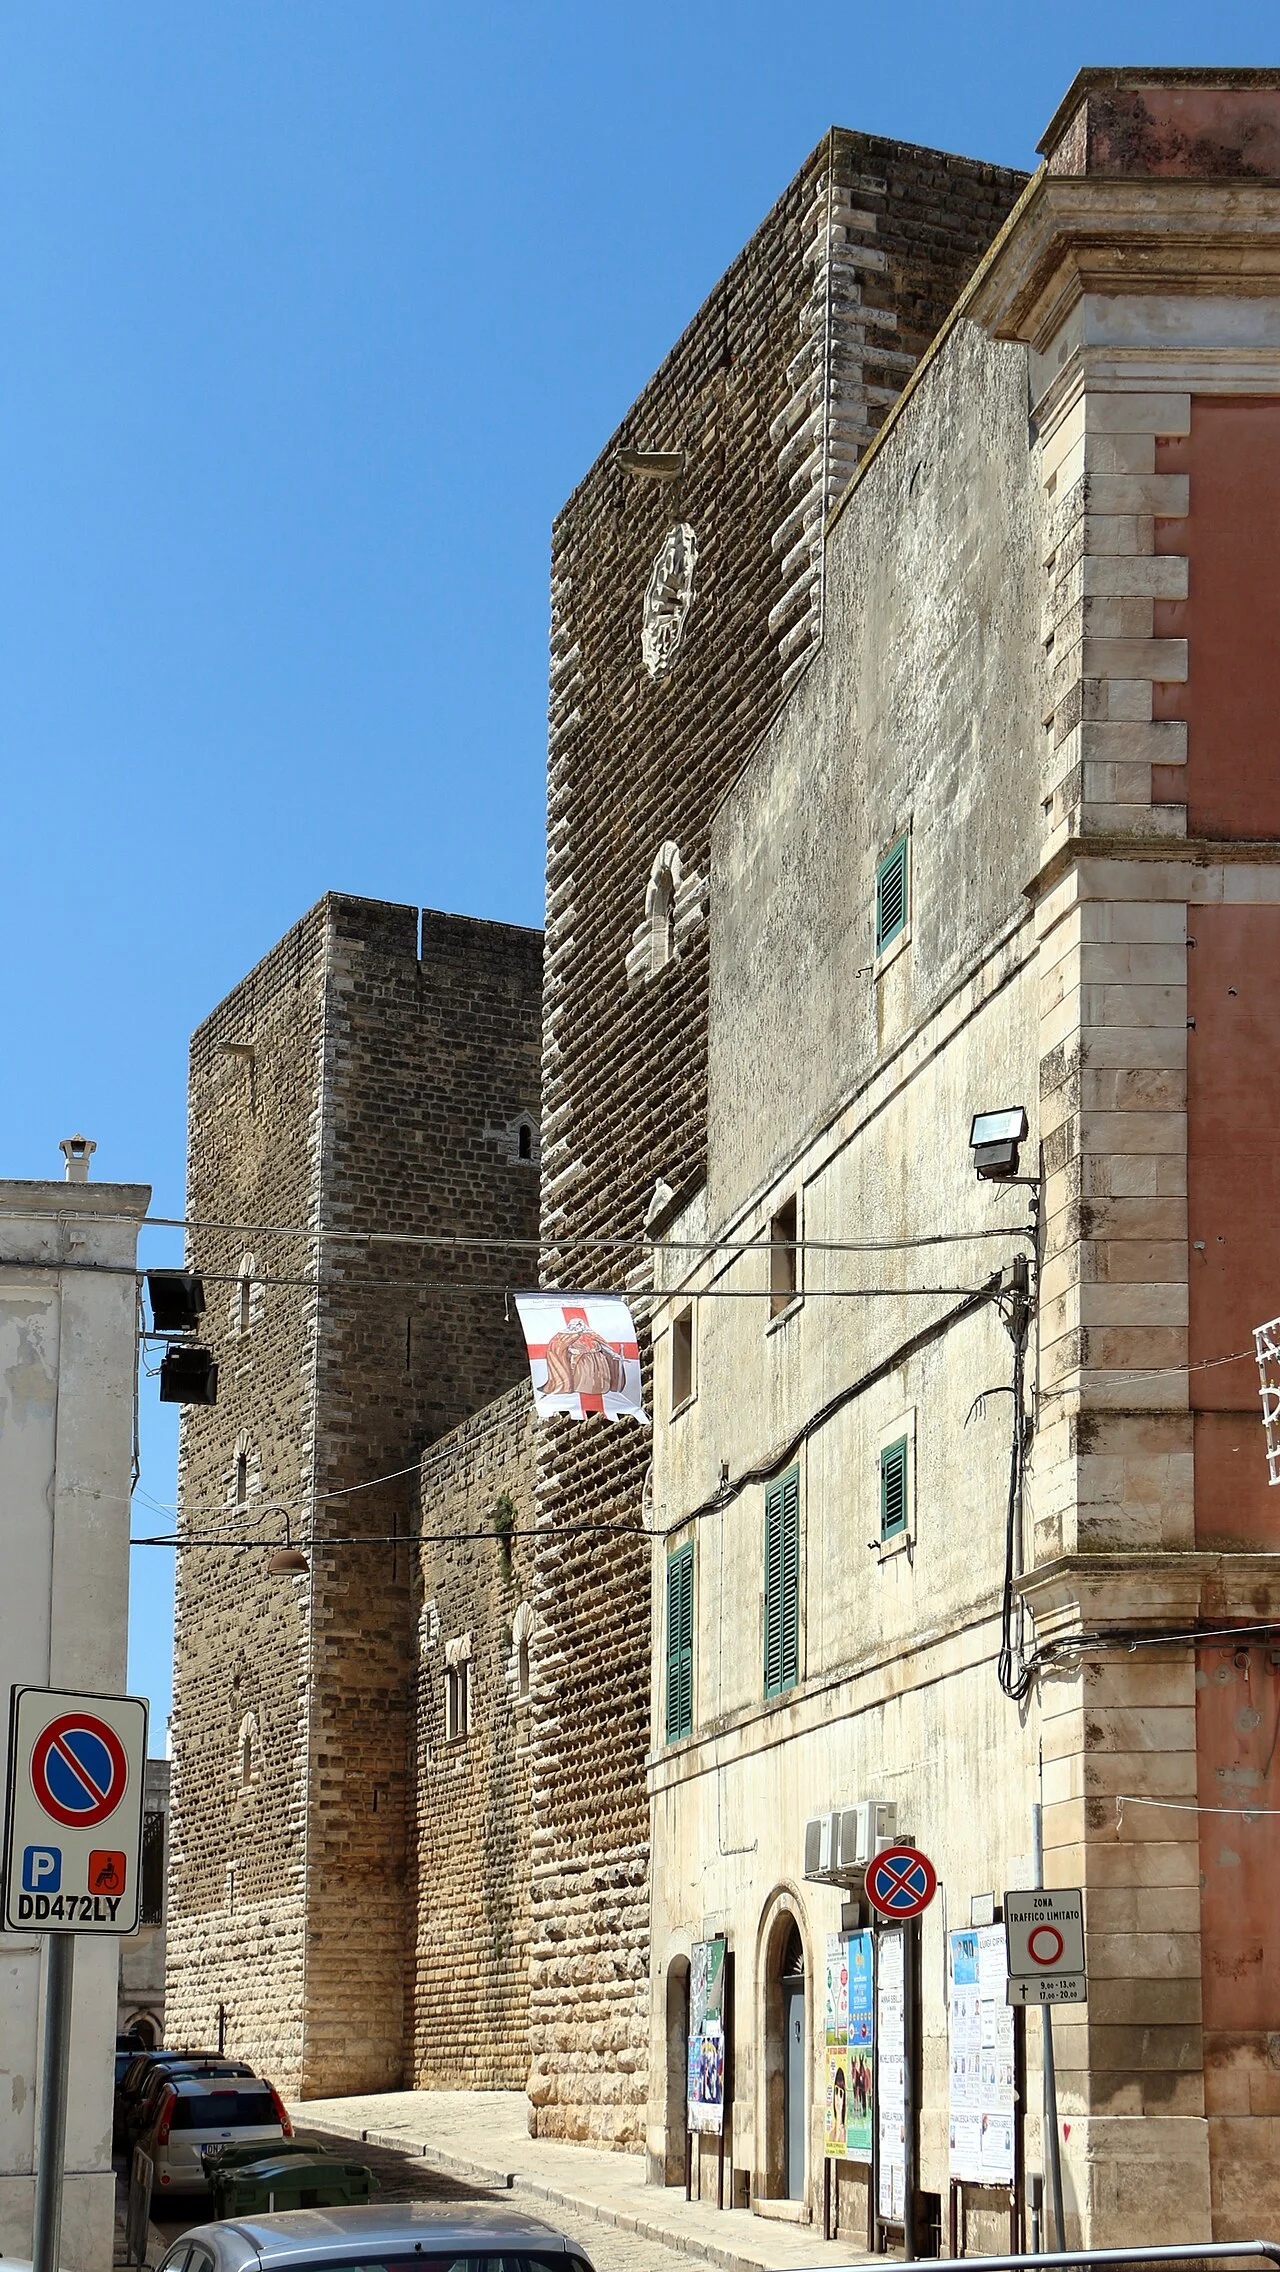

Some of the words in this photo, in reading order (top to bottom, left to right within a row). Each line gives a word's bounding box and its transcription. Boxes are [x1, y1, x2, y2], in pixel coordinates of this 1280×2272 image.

[32, 1851, 55, 1887] P
[18, 1894, 121, 1921] DD472LY
[1033, 1898, 1053, 1907] ZONA
[1010, 1912, 1045, 1922] TRAFFICO
[1047, 1910, 1080, 1920] LIMITATO
